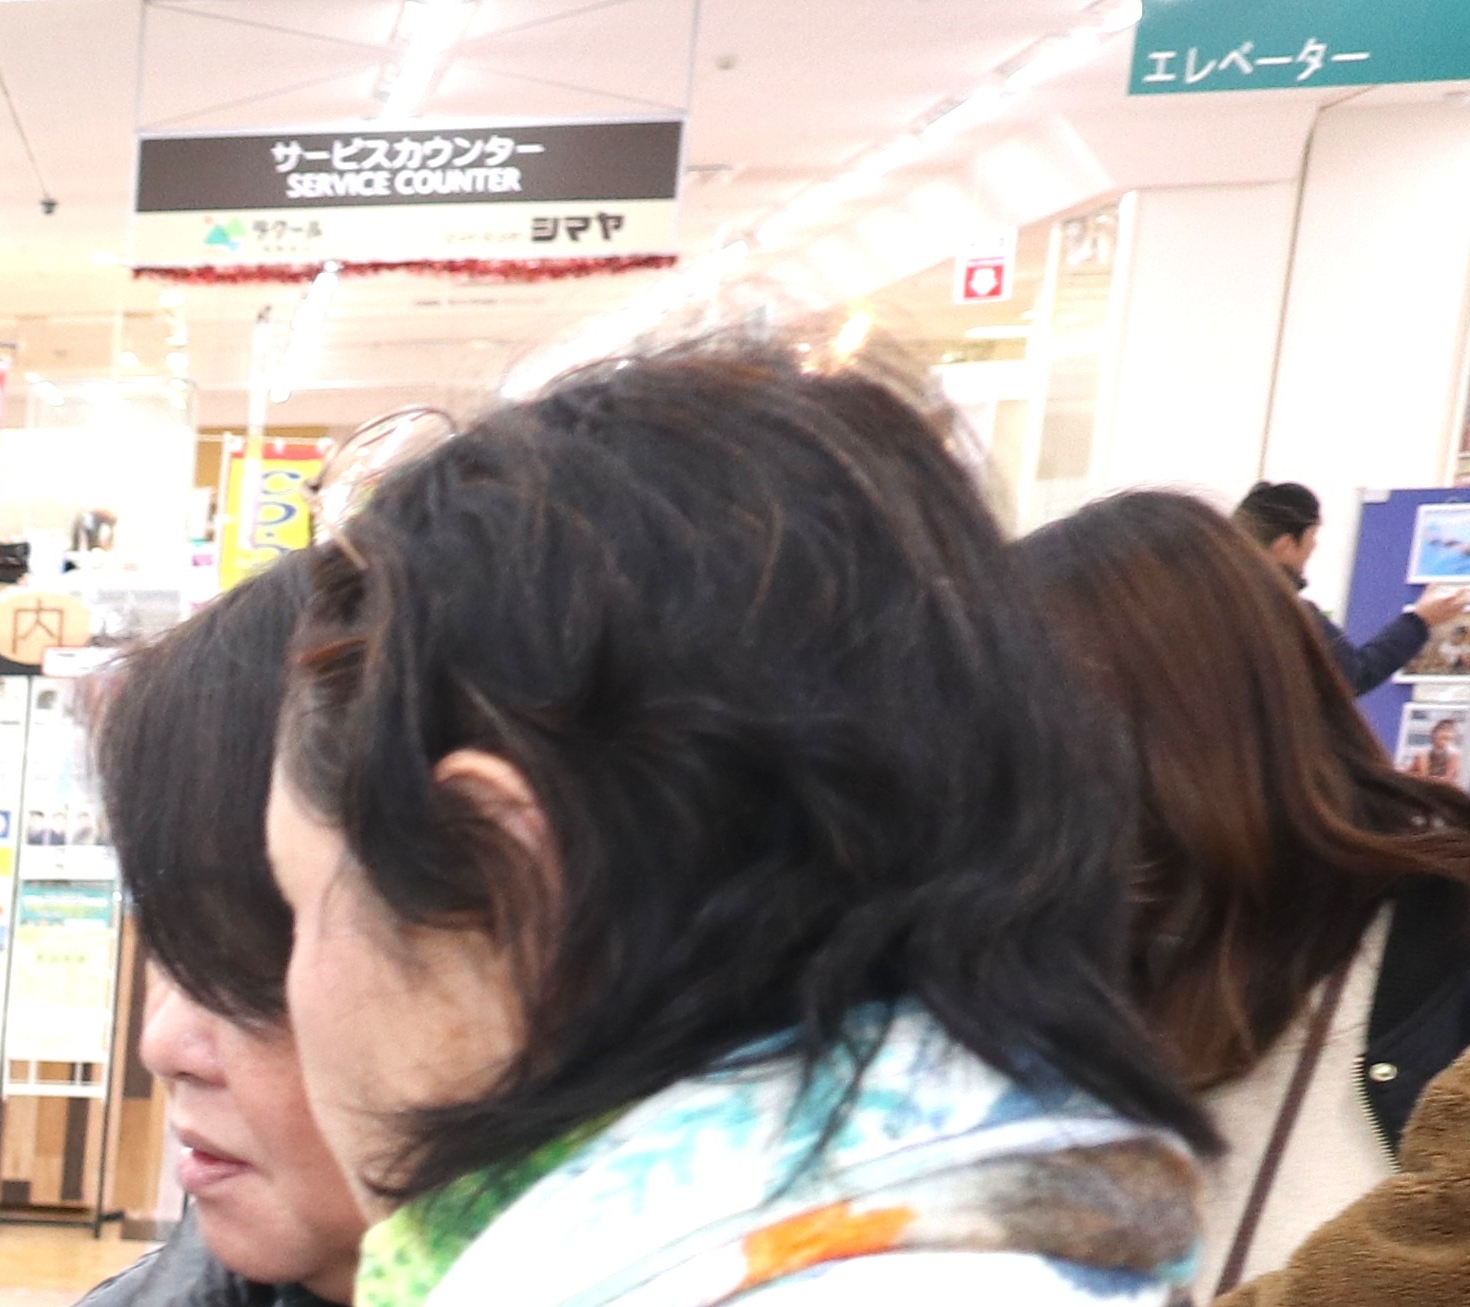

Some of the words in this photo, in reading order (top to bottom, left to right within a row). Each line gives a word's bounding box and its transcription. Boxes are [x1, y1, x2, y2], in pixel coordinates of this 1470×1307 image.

[1142, 37, 1371, 84] エレベーター
[272, 134, 545, 173] サービスカウンター
[286, 170, 391, 199] SERVICE
[394, 166, 522, 196] COUNTER
[530, 212, 625, 242] シマヤ
